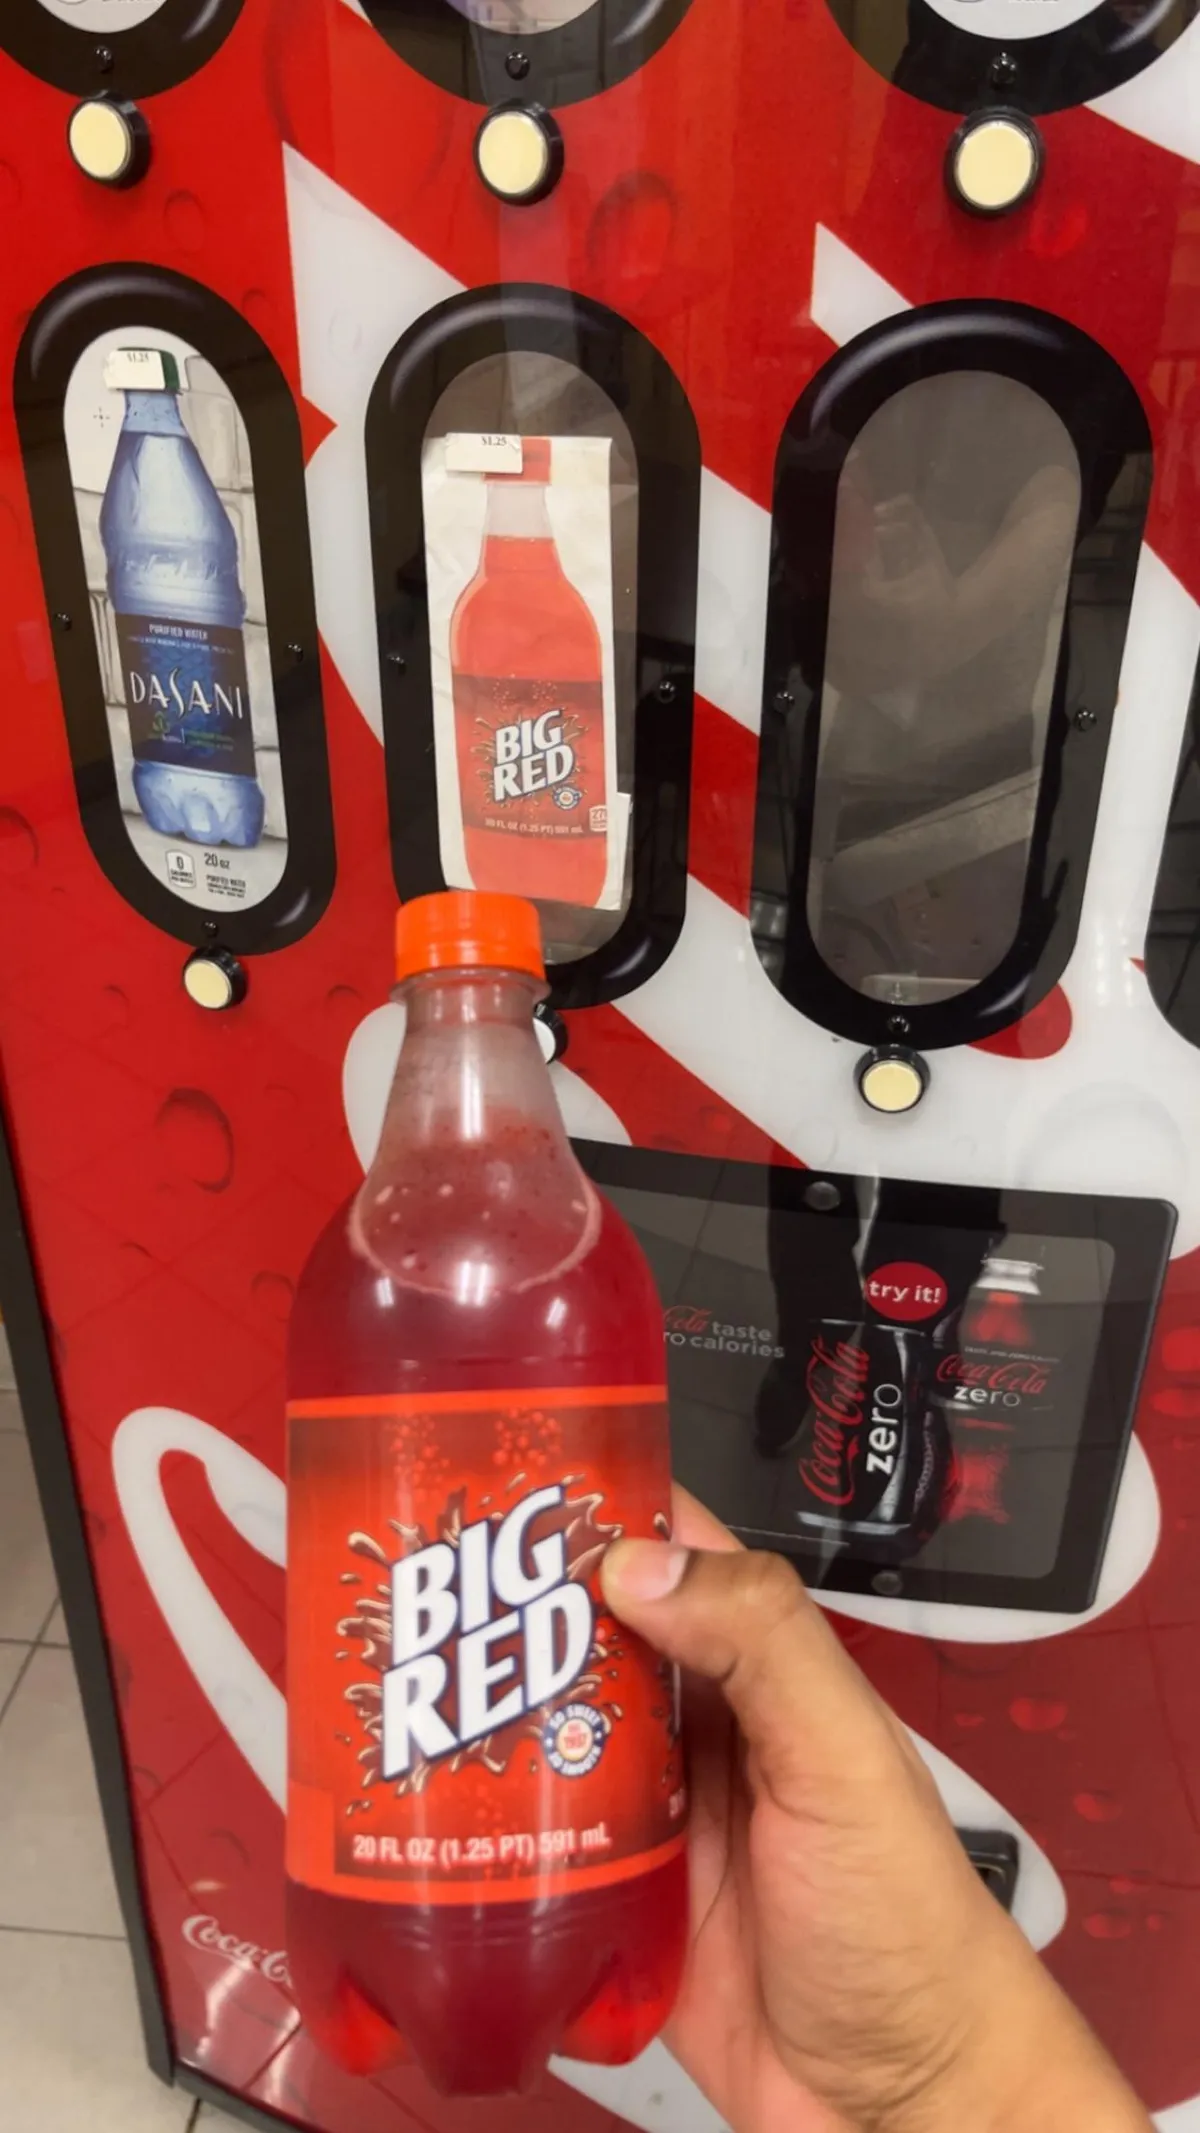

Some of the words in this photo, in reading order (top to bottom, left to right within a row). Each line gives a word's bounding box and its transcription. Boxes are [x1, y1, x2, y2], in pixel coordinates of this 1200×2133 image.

[480, 435, 507, 446] $1.25
[149, 623, 183, 637] PURIFIED
[129, 667, 243, 720] DASANI
[494, 708, 564, 766] BIG
[493, 743, 576, 803] RED
[204, 852, 219, 868] 20
[219, 859, 231, 870] oz
[869, 1280, 908, 1302] try
[914, 1285, 942, 1304] it!
[663, 1331, 686, 1346] ro
[690, 1336, 785, 1358] calories
[712, 1321, 772, 1341] taste
[954, 1385, 1021, 1407] zero
[866, 1383, 902, 1475] zero
[391, 1484, 568, 1668] BIG
[381, 1581, 594, 1782] RED
[353, 1834, 377, 1860] 20
[381, 1837, 402, 1862] FL
[407, 1838, 435, 1863] OZ
[440, 1837, 495, 1868] (1.25
[500, 1832, 536, 1867] PT)
[539, 1827, 575, 1856] 591
[581, 1821, 612, 1847] mL
